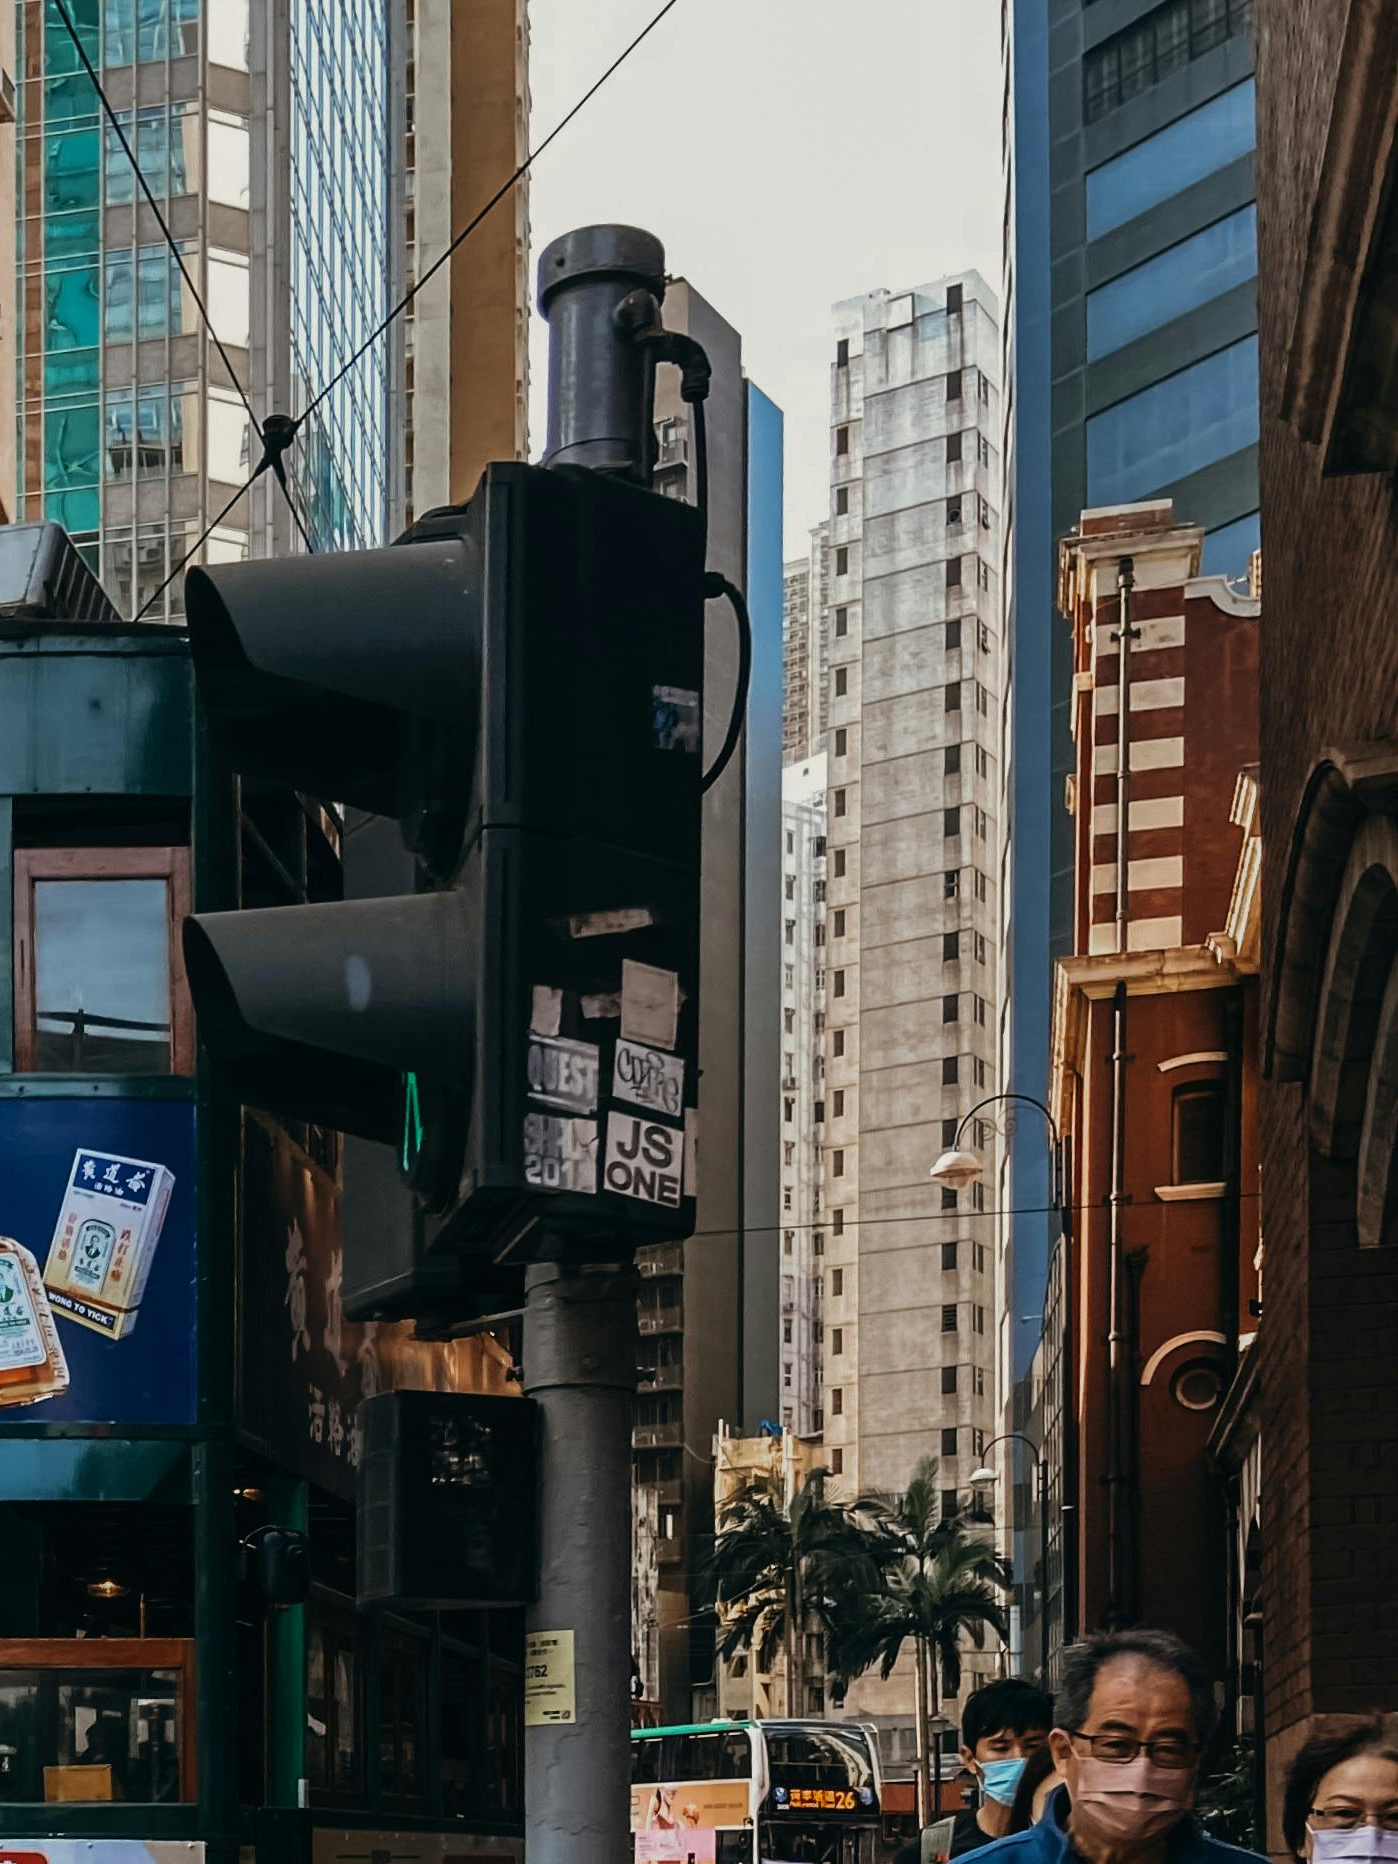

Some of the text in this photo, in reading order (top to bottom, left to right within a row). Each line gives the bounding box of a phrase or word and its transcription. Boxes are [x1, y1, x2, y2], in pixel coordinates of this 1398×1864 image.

[616, 1120, 673, 1169] JS
[607, 1161, 679, 1206] ONE
[48, 1291, 73, 1309] WONG
[73, 1304, 86, 1316] TO
[835, 1791, 855, 1810] 26
